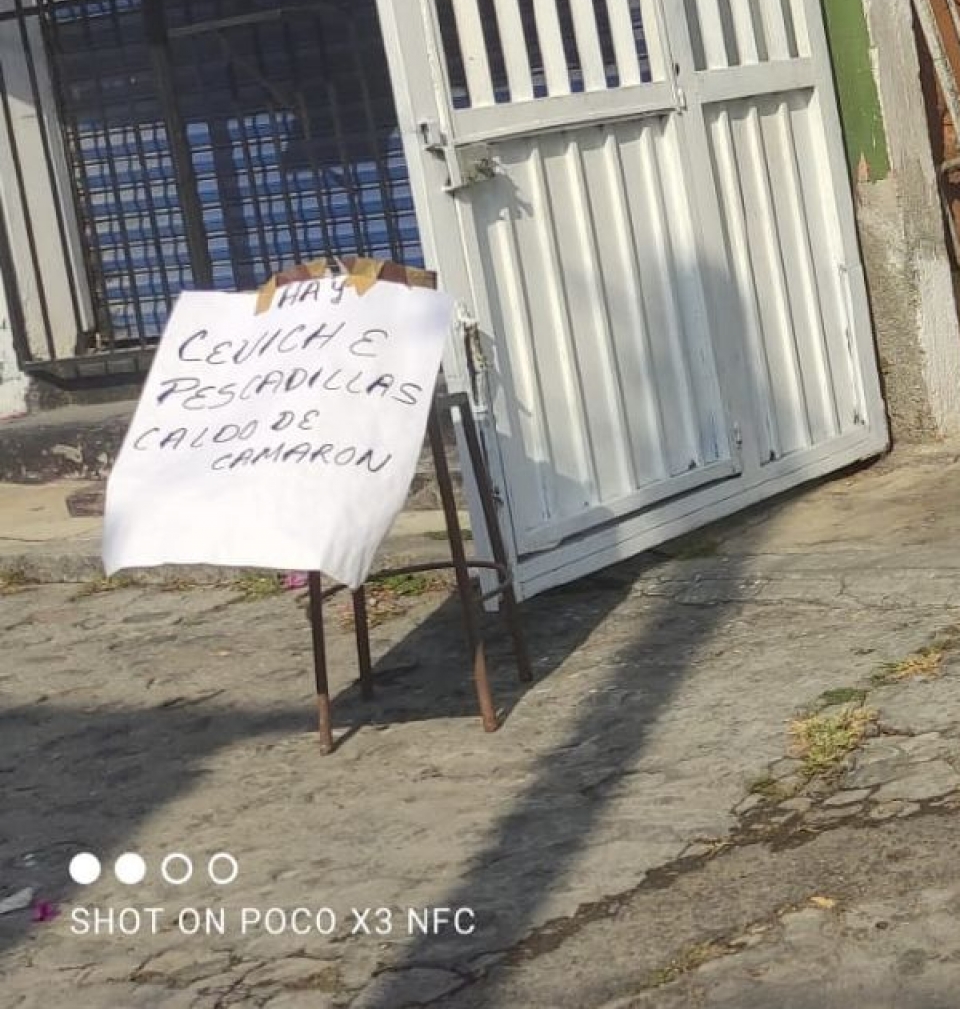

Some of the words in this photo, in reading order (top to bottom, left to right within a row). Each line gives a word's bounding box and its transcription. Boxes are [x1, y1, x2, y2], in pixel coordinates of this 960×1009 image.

[277, 280, 345, 310] HAY
[178, 321, 388, 365] CEVICHE
[156, 367, 422, 411] PESCADILLAS
[133, 420, 259, 451] CALDO
[271, 409, 320, 431] DE
[210, 442, 392, 473] CAMARON
